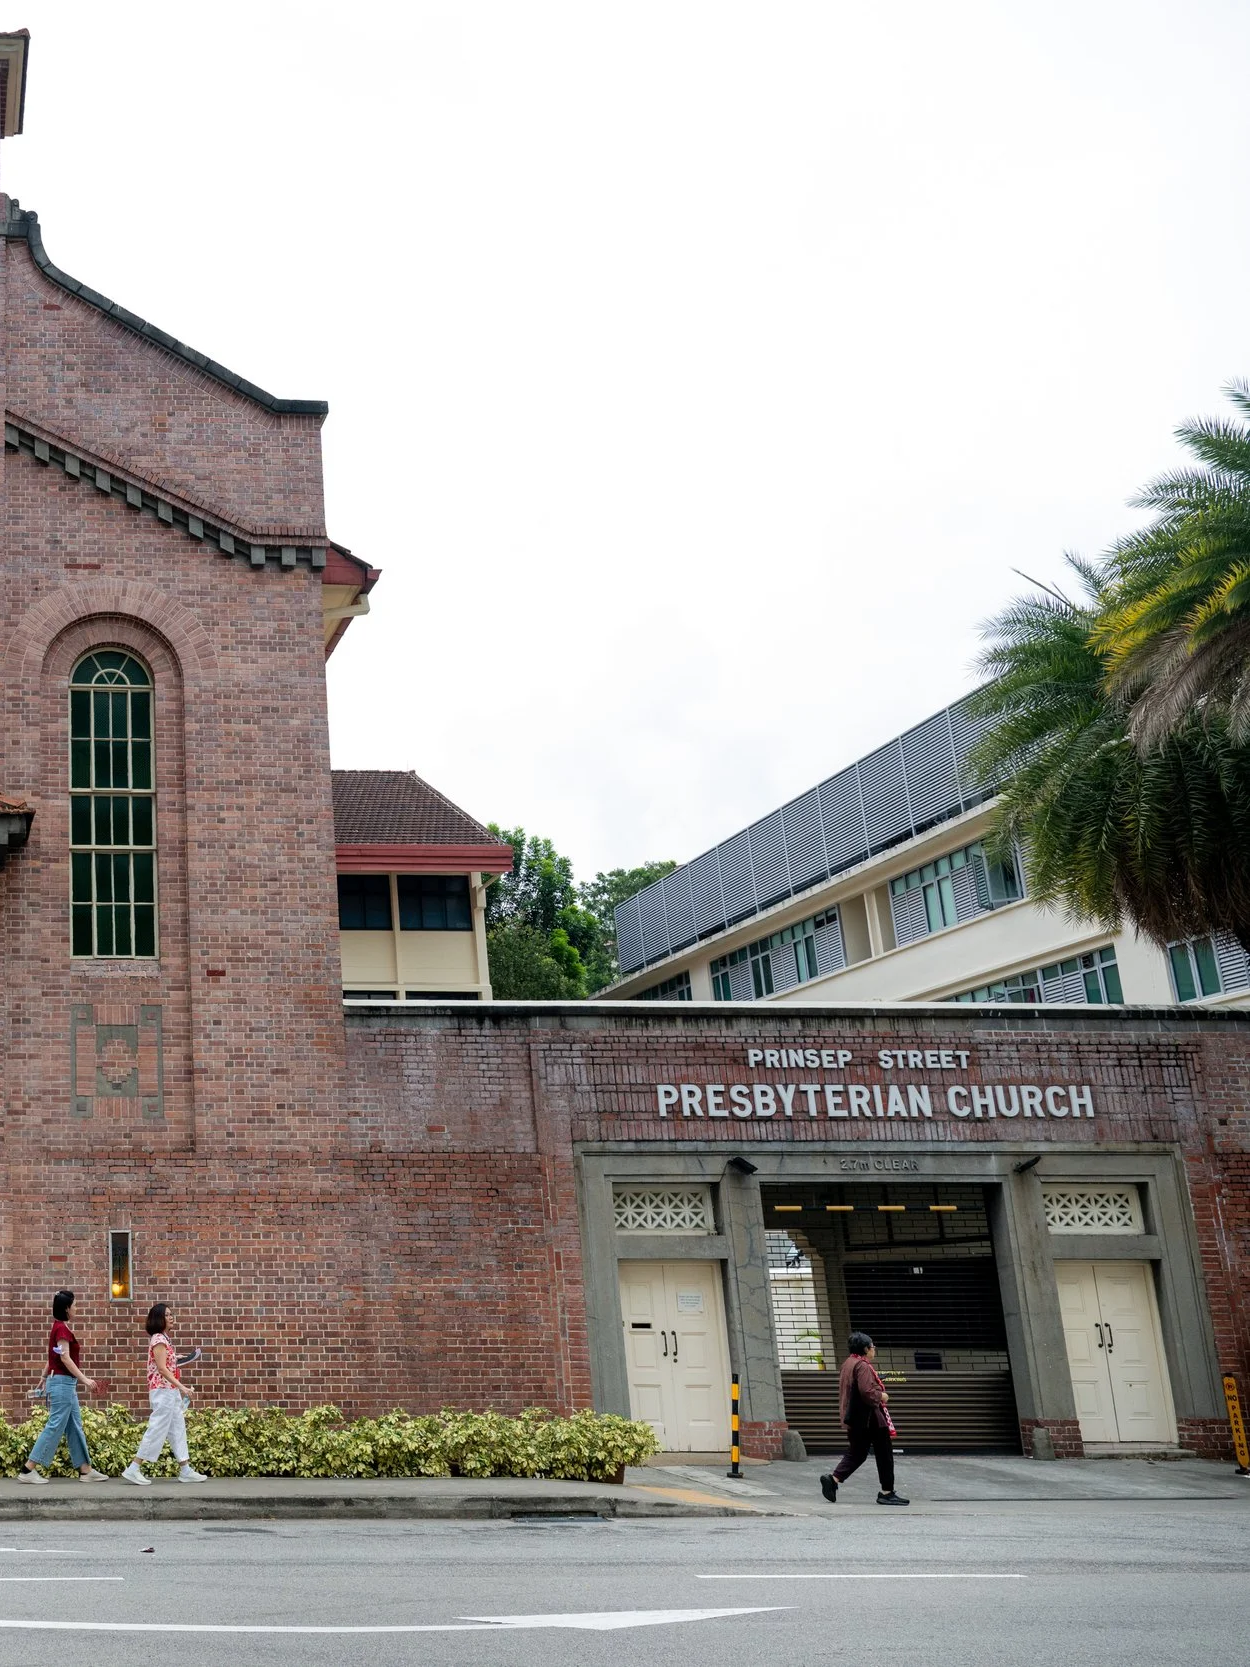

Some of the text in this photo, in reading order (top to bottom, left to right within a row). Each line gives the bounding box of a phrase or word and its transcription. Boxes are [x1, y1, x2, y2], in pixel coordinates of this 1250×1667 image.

[748, 1049, 970, 1070] PRINSEP STREET
[656, 1084, 1096, 1119] PRESBYTERIAN CHURCH
[840, 1159, 919, 1171] 2.7m CLEAR
[1232, 1405, 1246, 1457] PARKING
